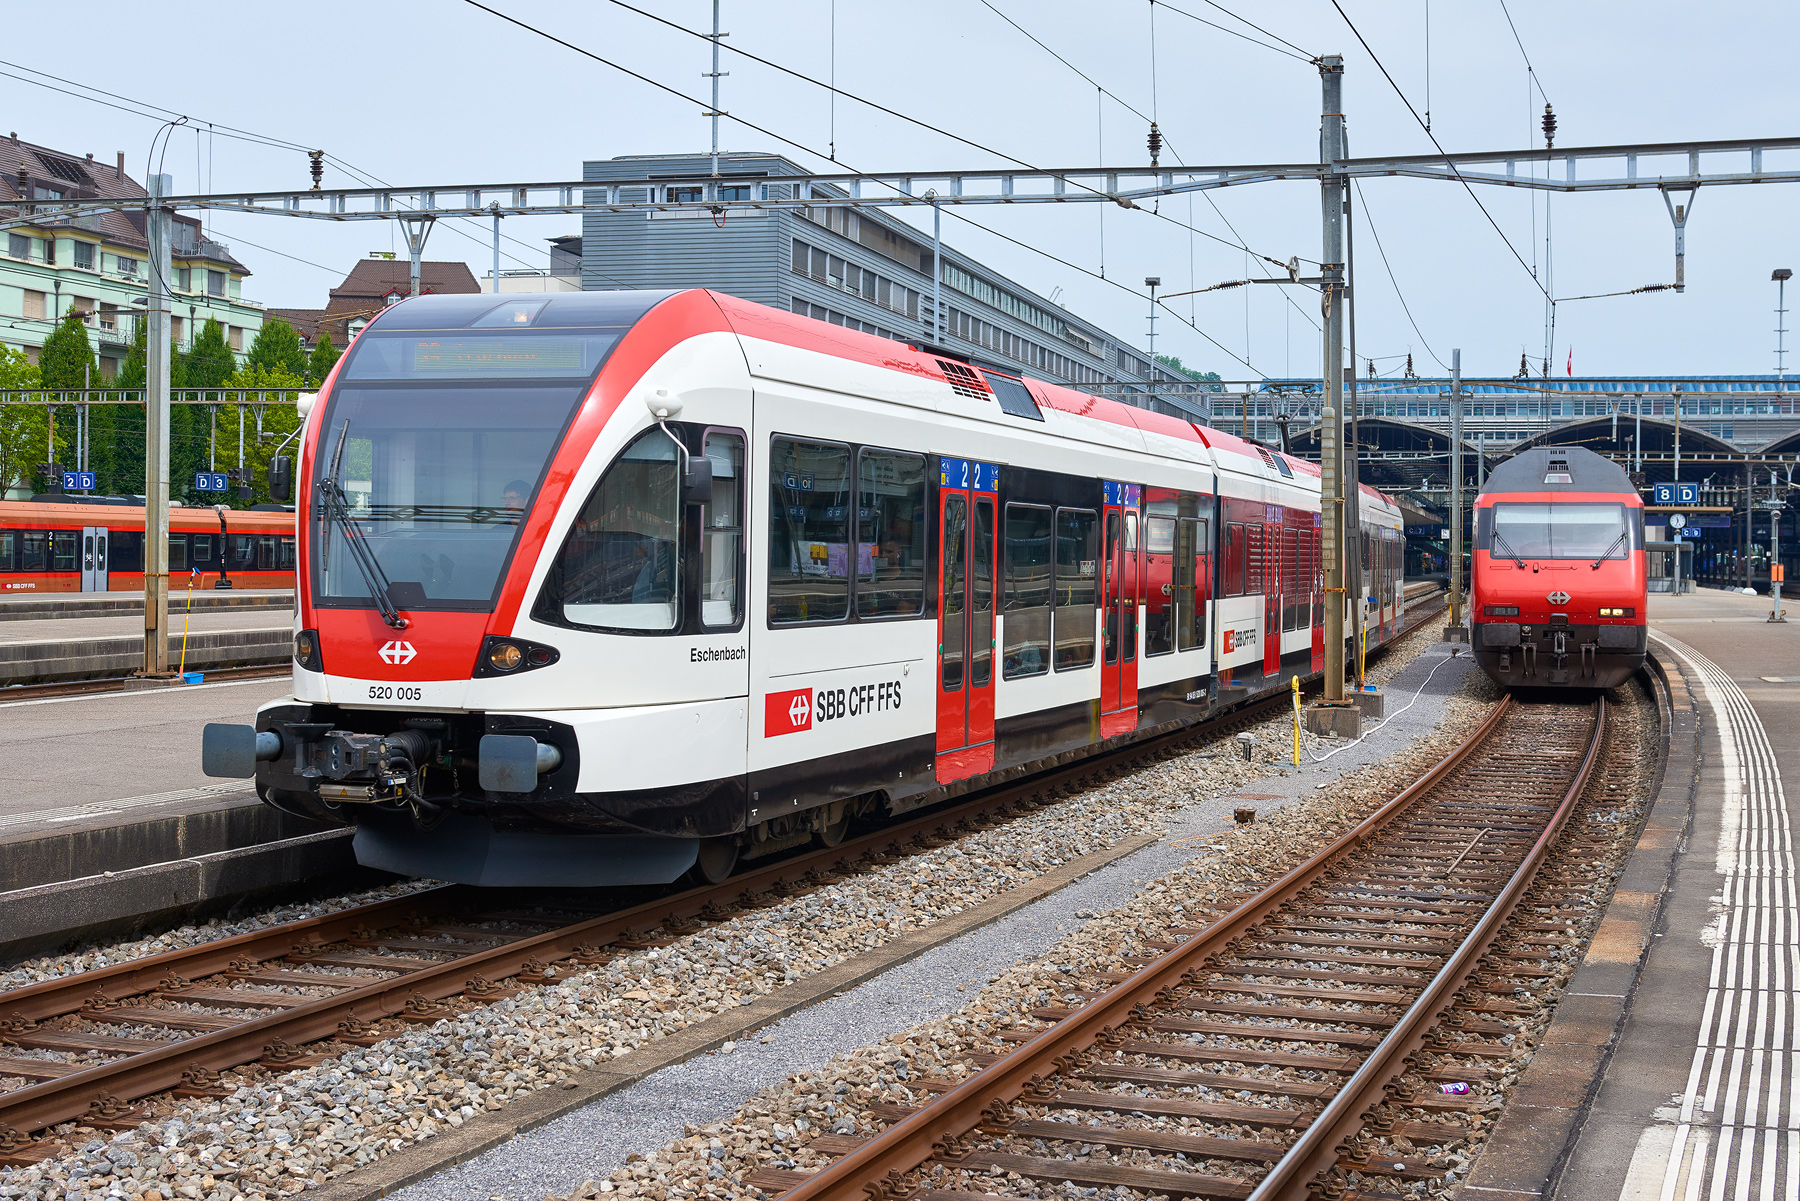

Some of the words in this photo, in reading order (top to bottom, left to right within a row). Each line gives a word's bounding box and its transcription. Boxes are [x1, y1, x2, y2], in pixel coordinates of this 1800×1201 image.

[961, 461, 968, 487] 2
[974, 463, 980, 488] 2
[67, 478, 74, 487] 2
[83, 478, 90, 487] D
[200, 479, 207, 488] D
[216, 479, 223, 488] 3
[1117, 483, 1122, 504] 2
[1124, 484, 1129, 505] 2
[1661, 489, 1670, 500] 8
[1682, 489, 1692, 500] D
[48, 531, 53, 540] 2
[690, 645, 746, 662] Eschenbach
[368, 686, 393, 699] 520
[397, 687, 422, 700] 005
[816, 690, 846, 722] SBB
[849, 684, 875, 716] CFF
[877, 680, 902, 712] FFS
